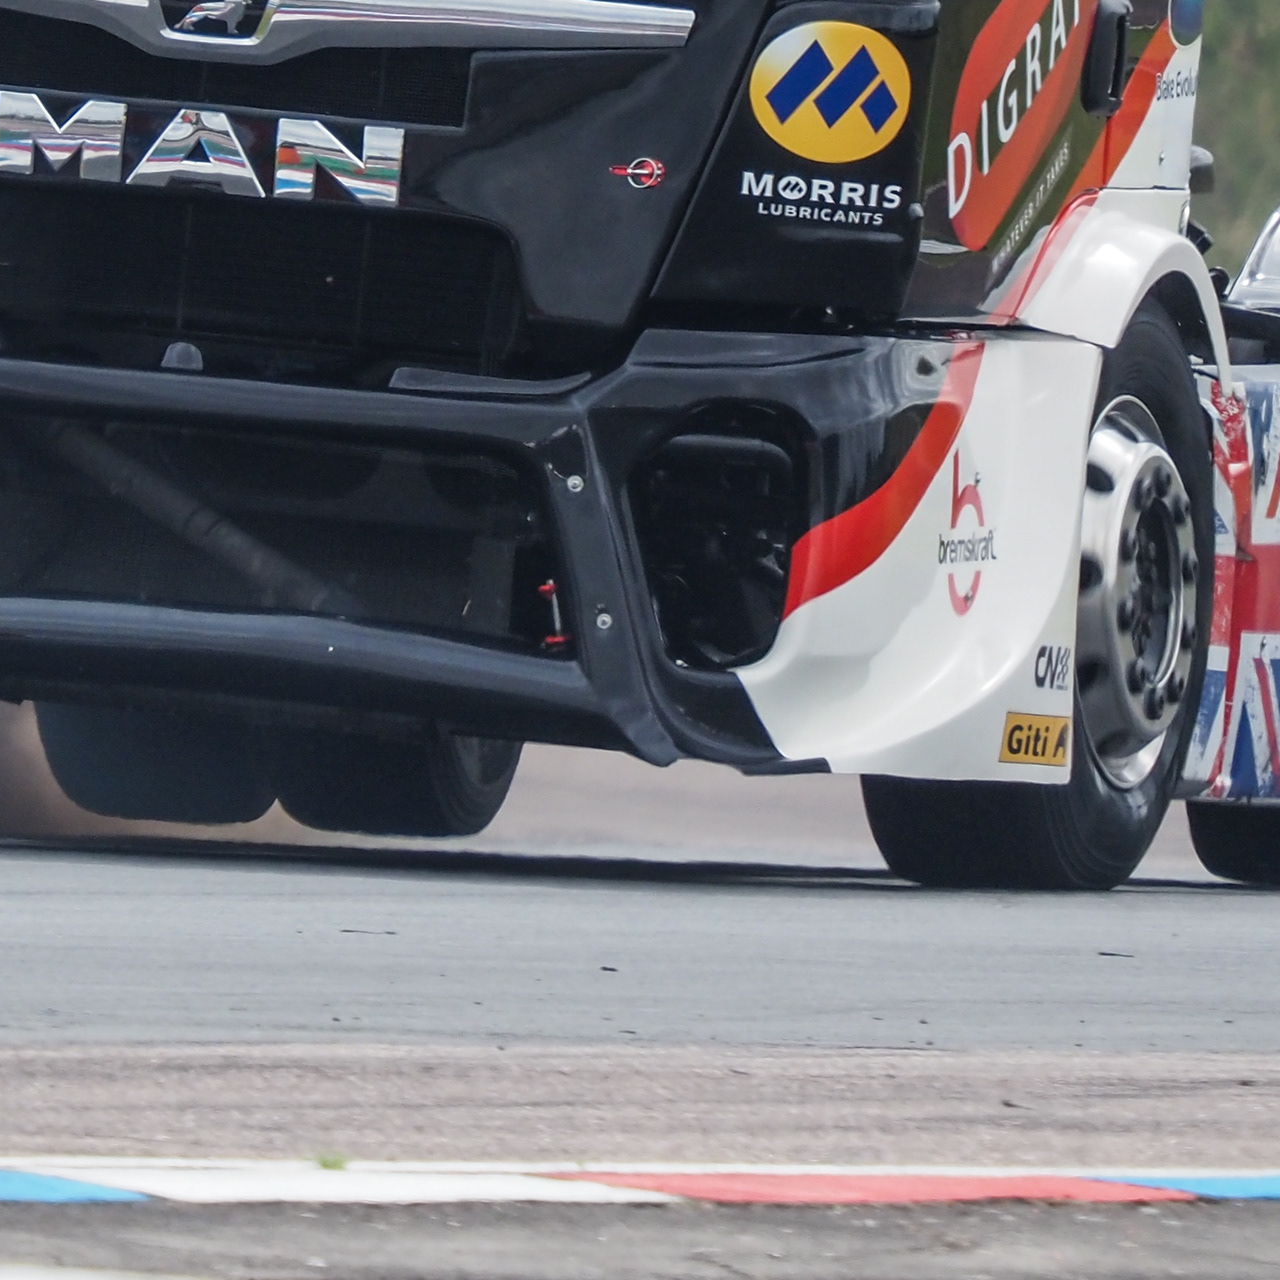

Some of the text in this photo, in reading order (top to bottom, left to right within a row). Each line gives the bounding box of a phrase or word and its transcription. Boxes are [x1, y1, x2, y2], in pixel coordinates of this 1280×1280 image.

[740, 171, 902, 209] MORRIS
[758, 202, 884, 226] LUBRICANTS
[1007, 723, 1050, 758] Giti
